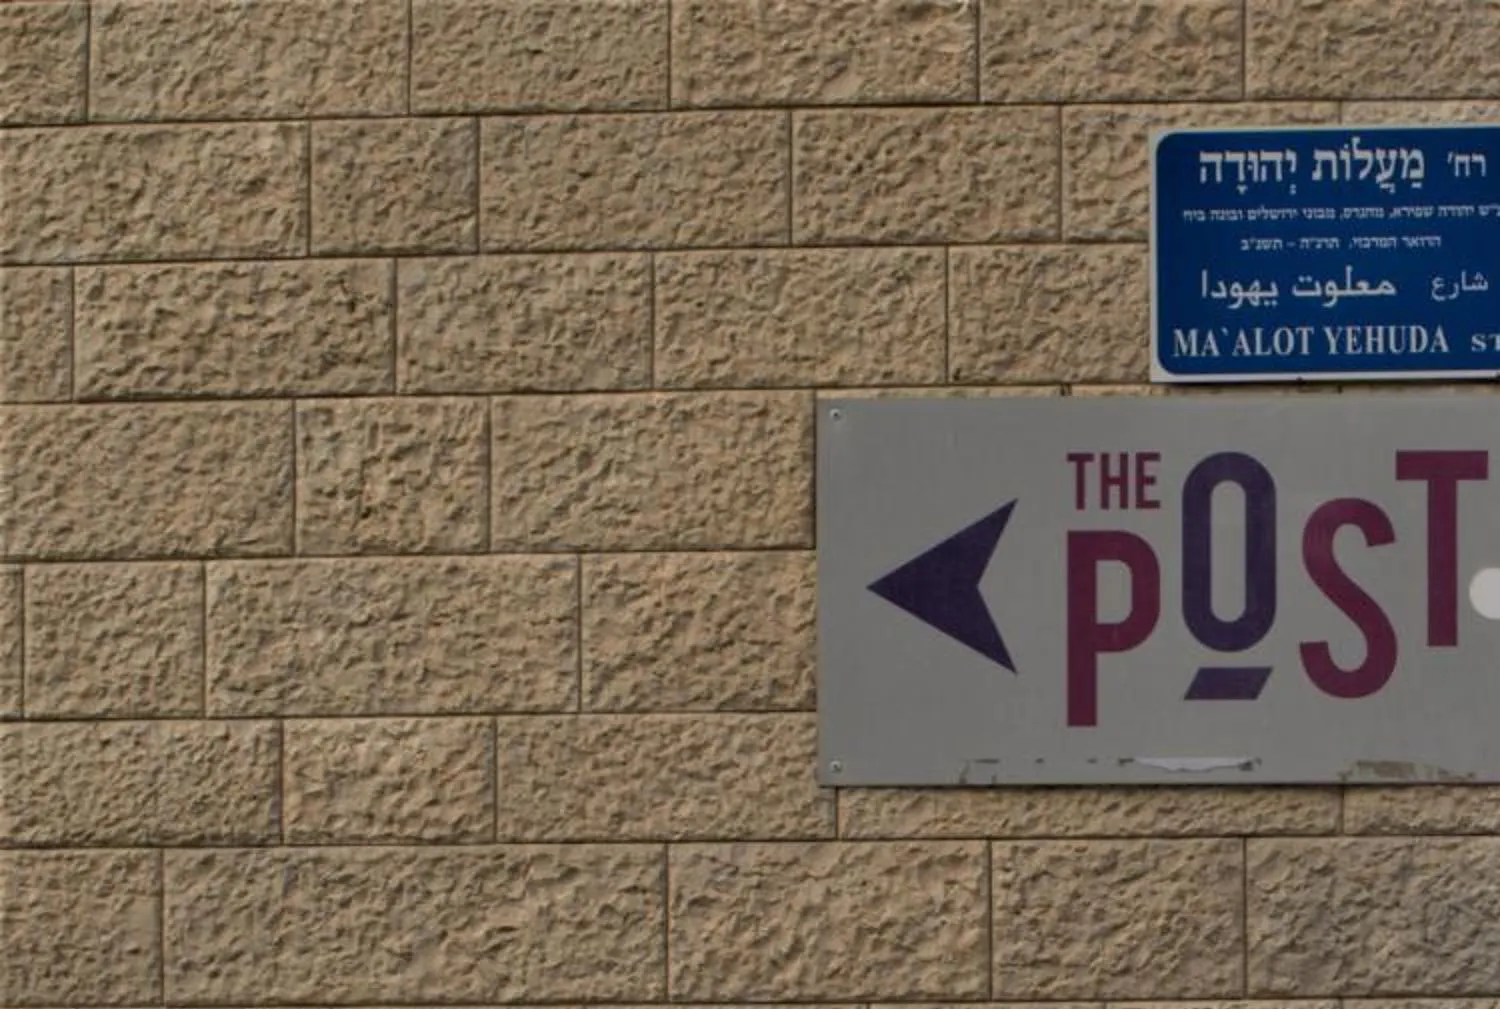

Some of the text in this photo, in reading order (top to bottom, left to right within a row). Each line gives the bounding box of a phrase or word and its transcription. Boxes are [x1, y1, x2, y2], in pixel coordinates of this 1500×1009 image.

[1248, 204, 1298, 220] ירושלים
[1201, 265, 1489, 307] شارع معلوت يهودا
[1323, 325, 1449, 355] YEHUDA
[1066, 452, 1161, 510] THE
[1066, 449, 1489, 727] POST
